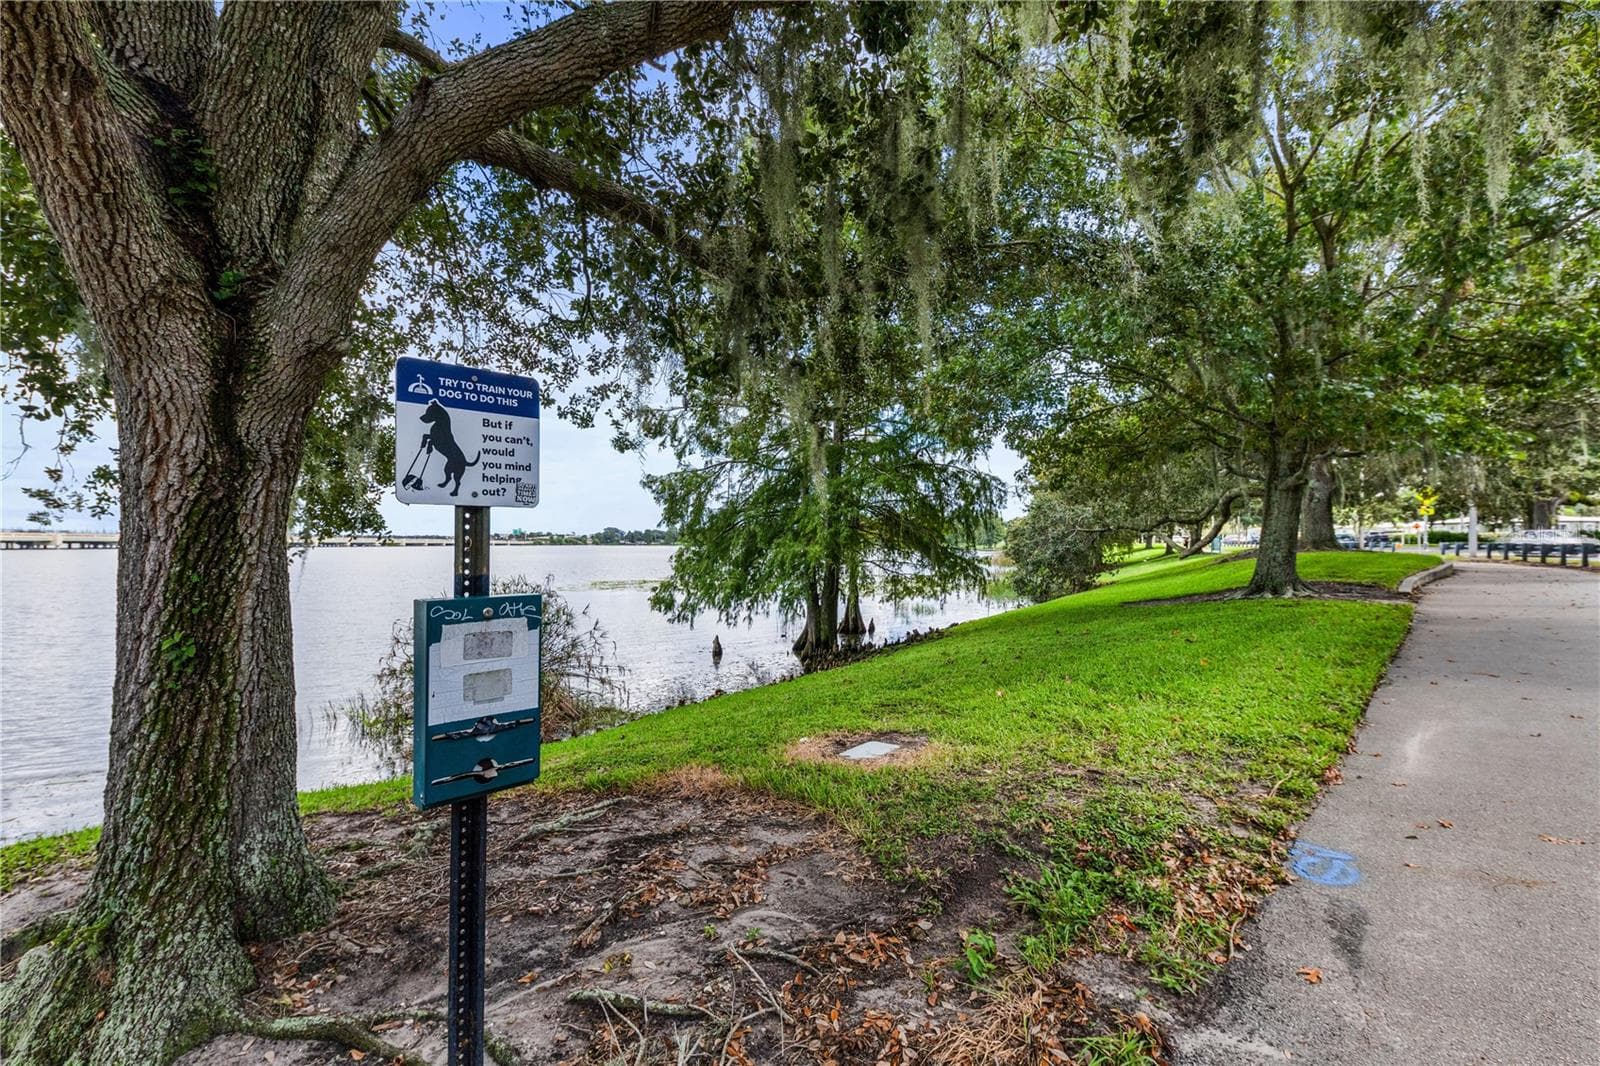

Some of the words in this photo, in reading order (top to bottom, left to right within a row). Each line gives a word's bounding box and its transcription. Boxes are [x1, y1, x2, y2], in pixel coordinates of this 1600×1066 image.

[438, 377, 458, 388] TRY
[460, 380, 474, 390] TO
[476, 383, 506, 394] TRAIN
[506, 388, 533, 399] YOUR
[438, 388, 462, 399] DOG
[464, 392, 478, 401] TO
[480, 394, 495, 404] DO
[496, 397, 518, 407] THIS
[482, 418, 502, 430] But
[505, 420, 512, 430] if
[482, 434, 502, 443] you
[504, 436, 533, 447] can't,
[482, 448, 515, 457] would
[482, 462, 502, 470] you
[504, 462, 532, 472] mind
[482, 488, 506, 496] out?
